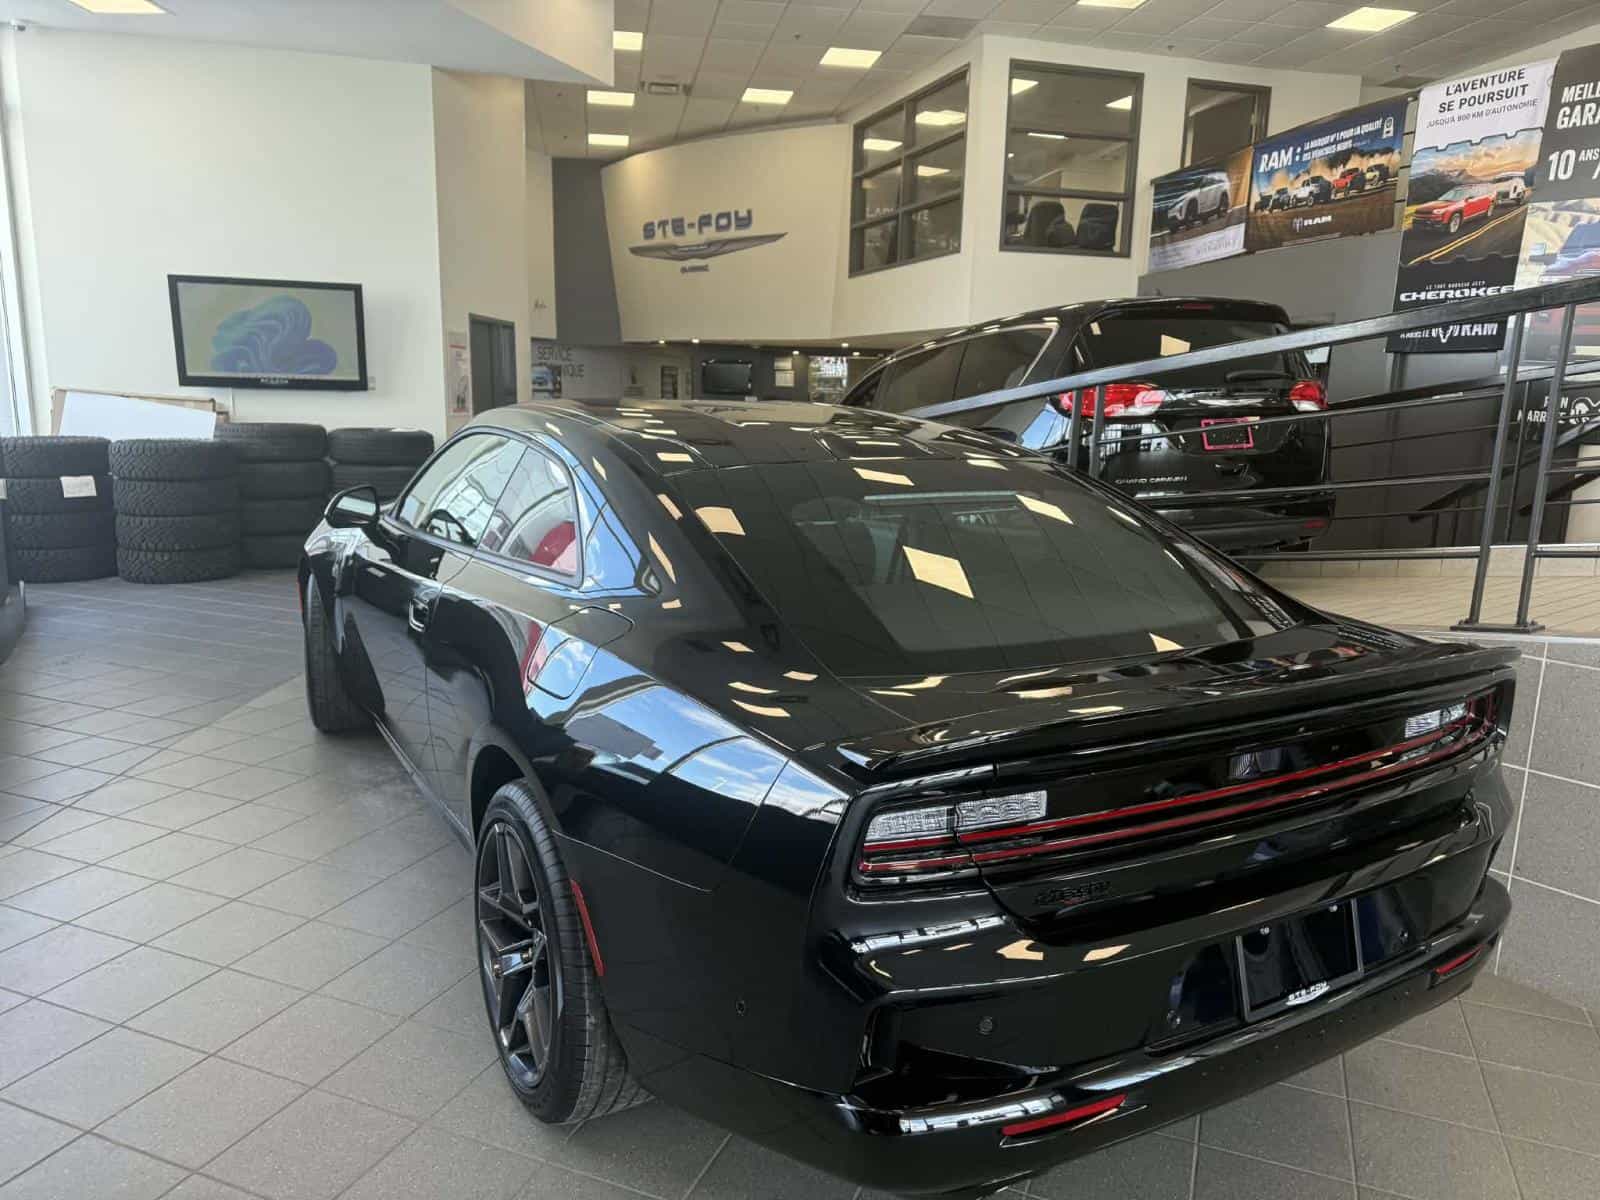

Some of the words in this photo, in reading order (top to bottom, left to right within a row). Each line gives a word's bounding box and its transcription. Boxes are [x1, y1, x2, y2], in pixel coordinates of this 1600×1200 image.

[1446, 68, 1526, 96] L'AVENTURE
[1438, 101, 1455, 114] SE
[1459, 84, 1529, 110] POURSUIT
[1548, 150, 1576, 181] 10
[1579, 150, 1599, 162] ANS
[642, 208, 753, 241] STE-FOY
[1303, 215, 1332, 227] RAM
